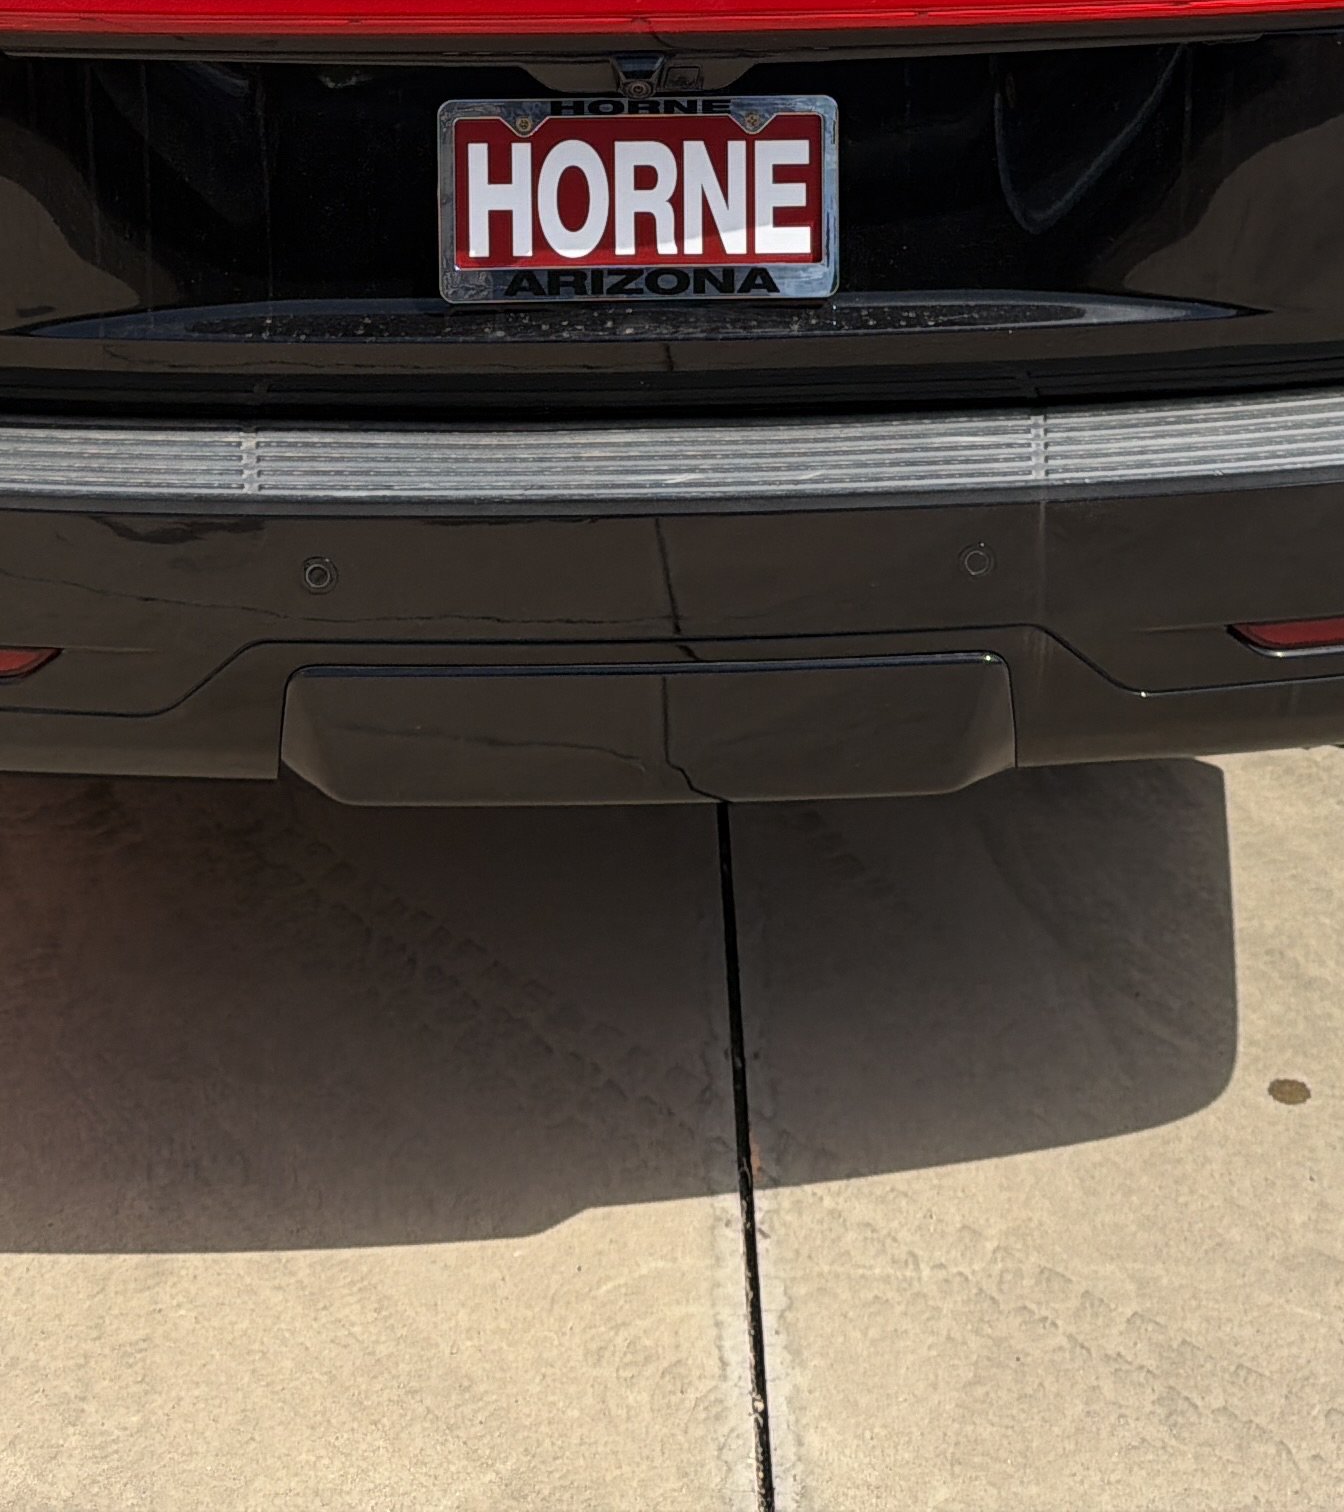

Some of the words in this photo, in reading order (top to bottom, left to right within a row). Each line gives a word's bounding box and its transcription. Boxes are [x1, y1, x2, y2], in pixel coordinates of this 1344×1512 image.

[550, 99, 732, 115] HORNE
[467, 139, 812, 258] HORNE
[503, 268, 781, 297] ARIZONA
